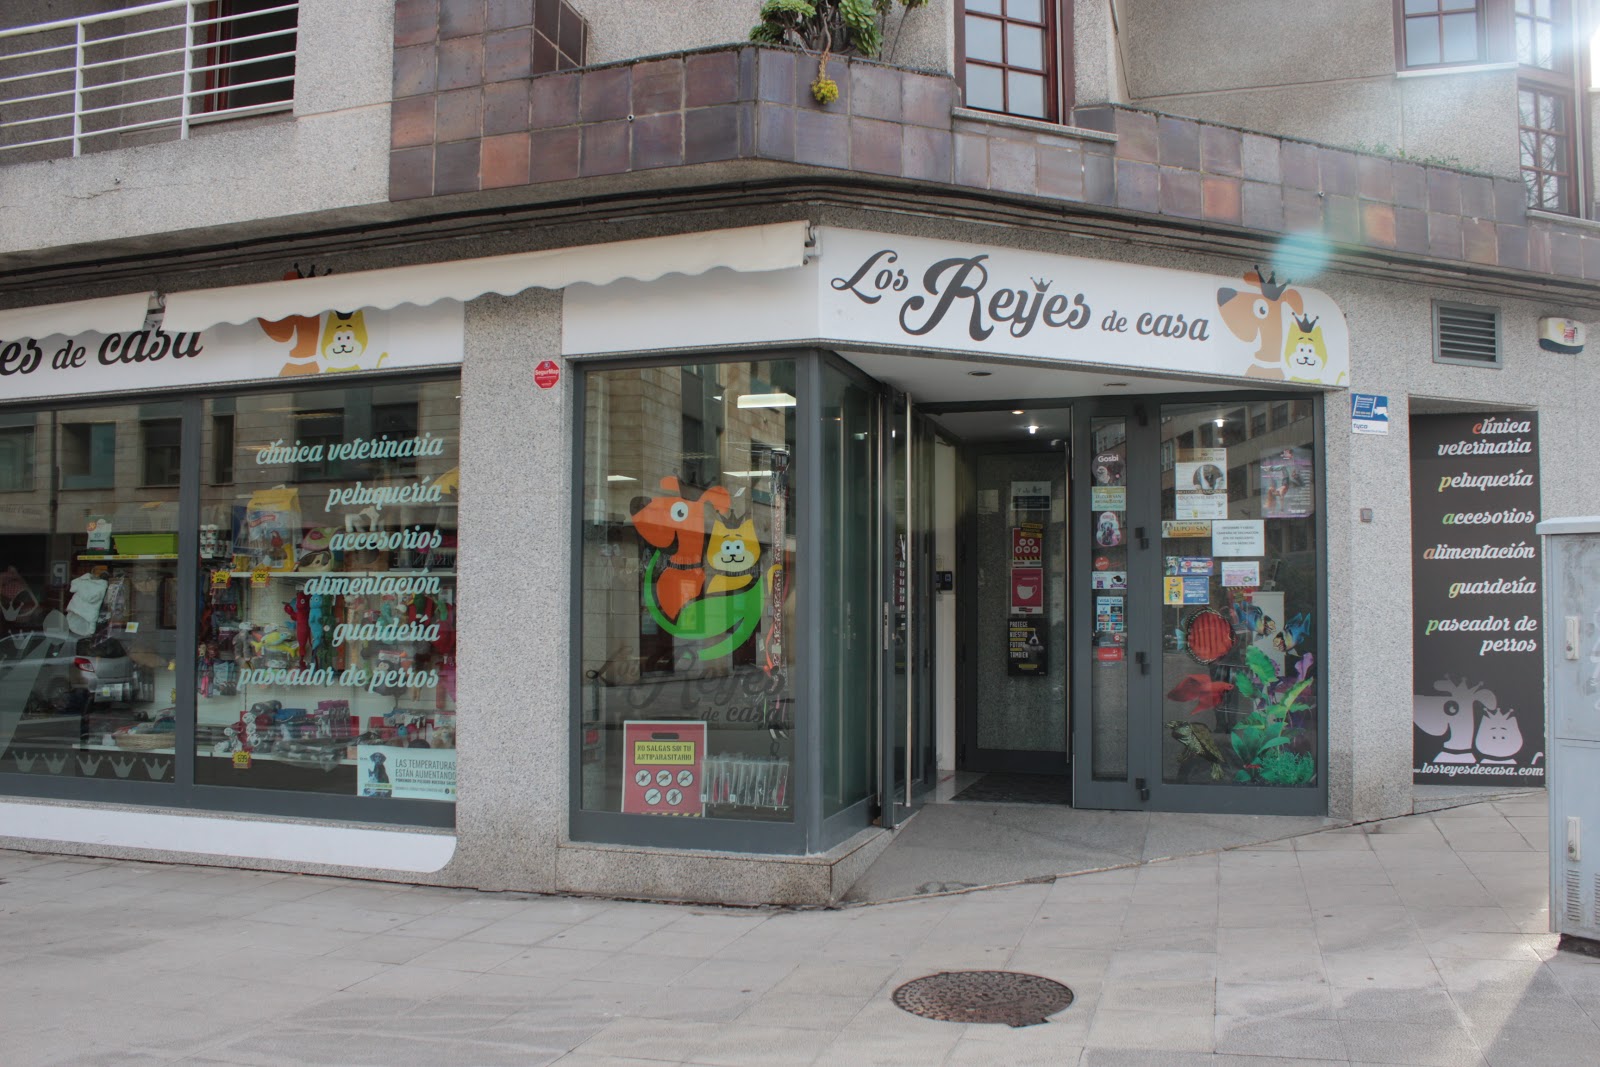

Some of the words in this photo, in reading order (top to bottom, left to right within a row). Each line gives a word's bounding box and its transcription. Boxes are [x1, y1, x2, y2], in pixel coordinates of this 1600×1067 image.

[831, 250, 909, 304] Los
[899, 254, 1091, 342] Reyes
[1101, 310, 1128, 333] de
[1136, 312, 1210, 341] casa
[0, 338, 43, 376] es
[52, 339, 87, 370] de
[1472, 416, 1532, 434] clínica
[256, 438, 323, 465] clínica
[327, 432, 444, 461] veterinaria
[1437, 438, 1532, 456] veterinaria
[1098, 454, 1119, 463] Gosbi
[1437, 469, 1534, 493] peluquería
[324, 476, 443, 513] peluquería
[1442, 508, 1535, 525] accesorios
[329, 525, 442, 551] accesorios
[1423, 541, 1536, 560] alimentación
[303, 567, 441, 596] alimentación
[1448, 576, 1537, 599] guardería
[332, 614, 441, 647] guardería
[1425, 615, 1511, 636] paseador
[1514, 615, 1538, 632] de
[1480, 638, 1537, 656] perros
[236, 663, 335, 691] paseador
[339, 663, 367, 687] de
[367, 665, 440, 694] perros
[636, 753, 692, 761] ANTIPARASITARIO
[637, 744, 646, 752] NO
[646, 744, 671, 752] SALGAS
[395, 758, 408, 768] LAS
[409, 759, 456, 770] TEMPERATURAS
[395, 768, 414, 778] ESTÁN
[415, 769, 456, 780] AUMENTANDO
